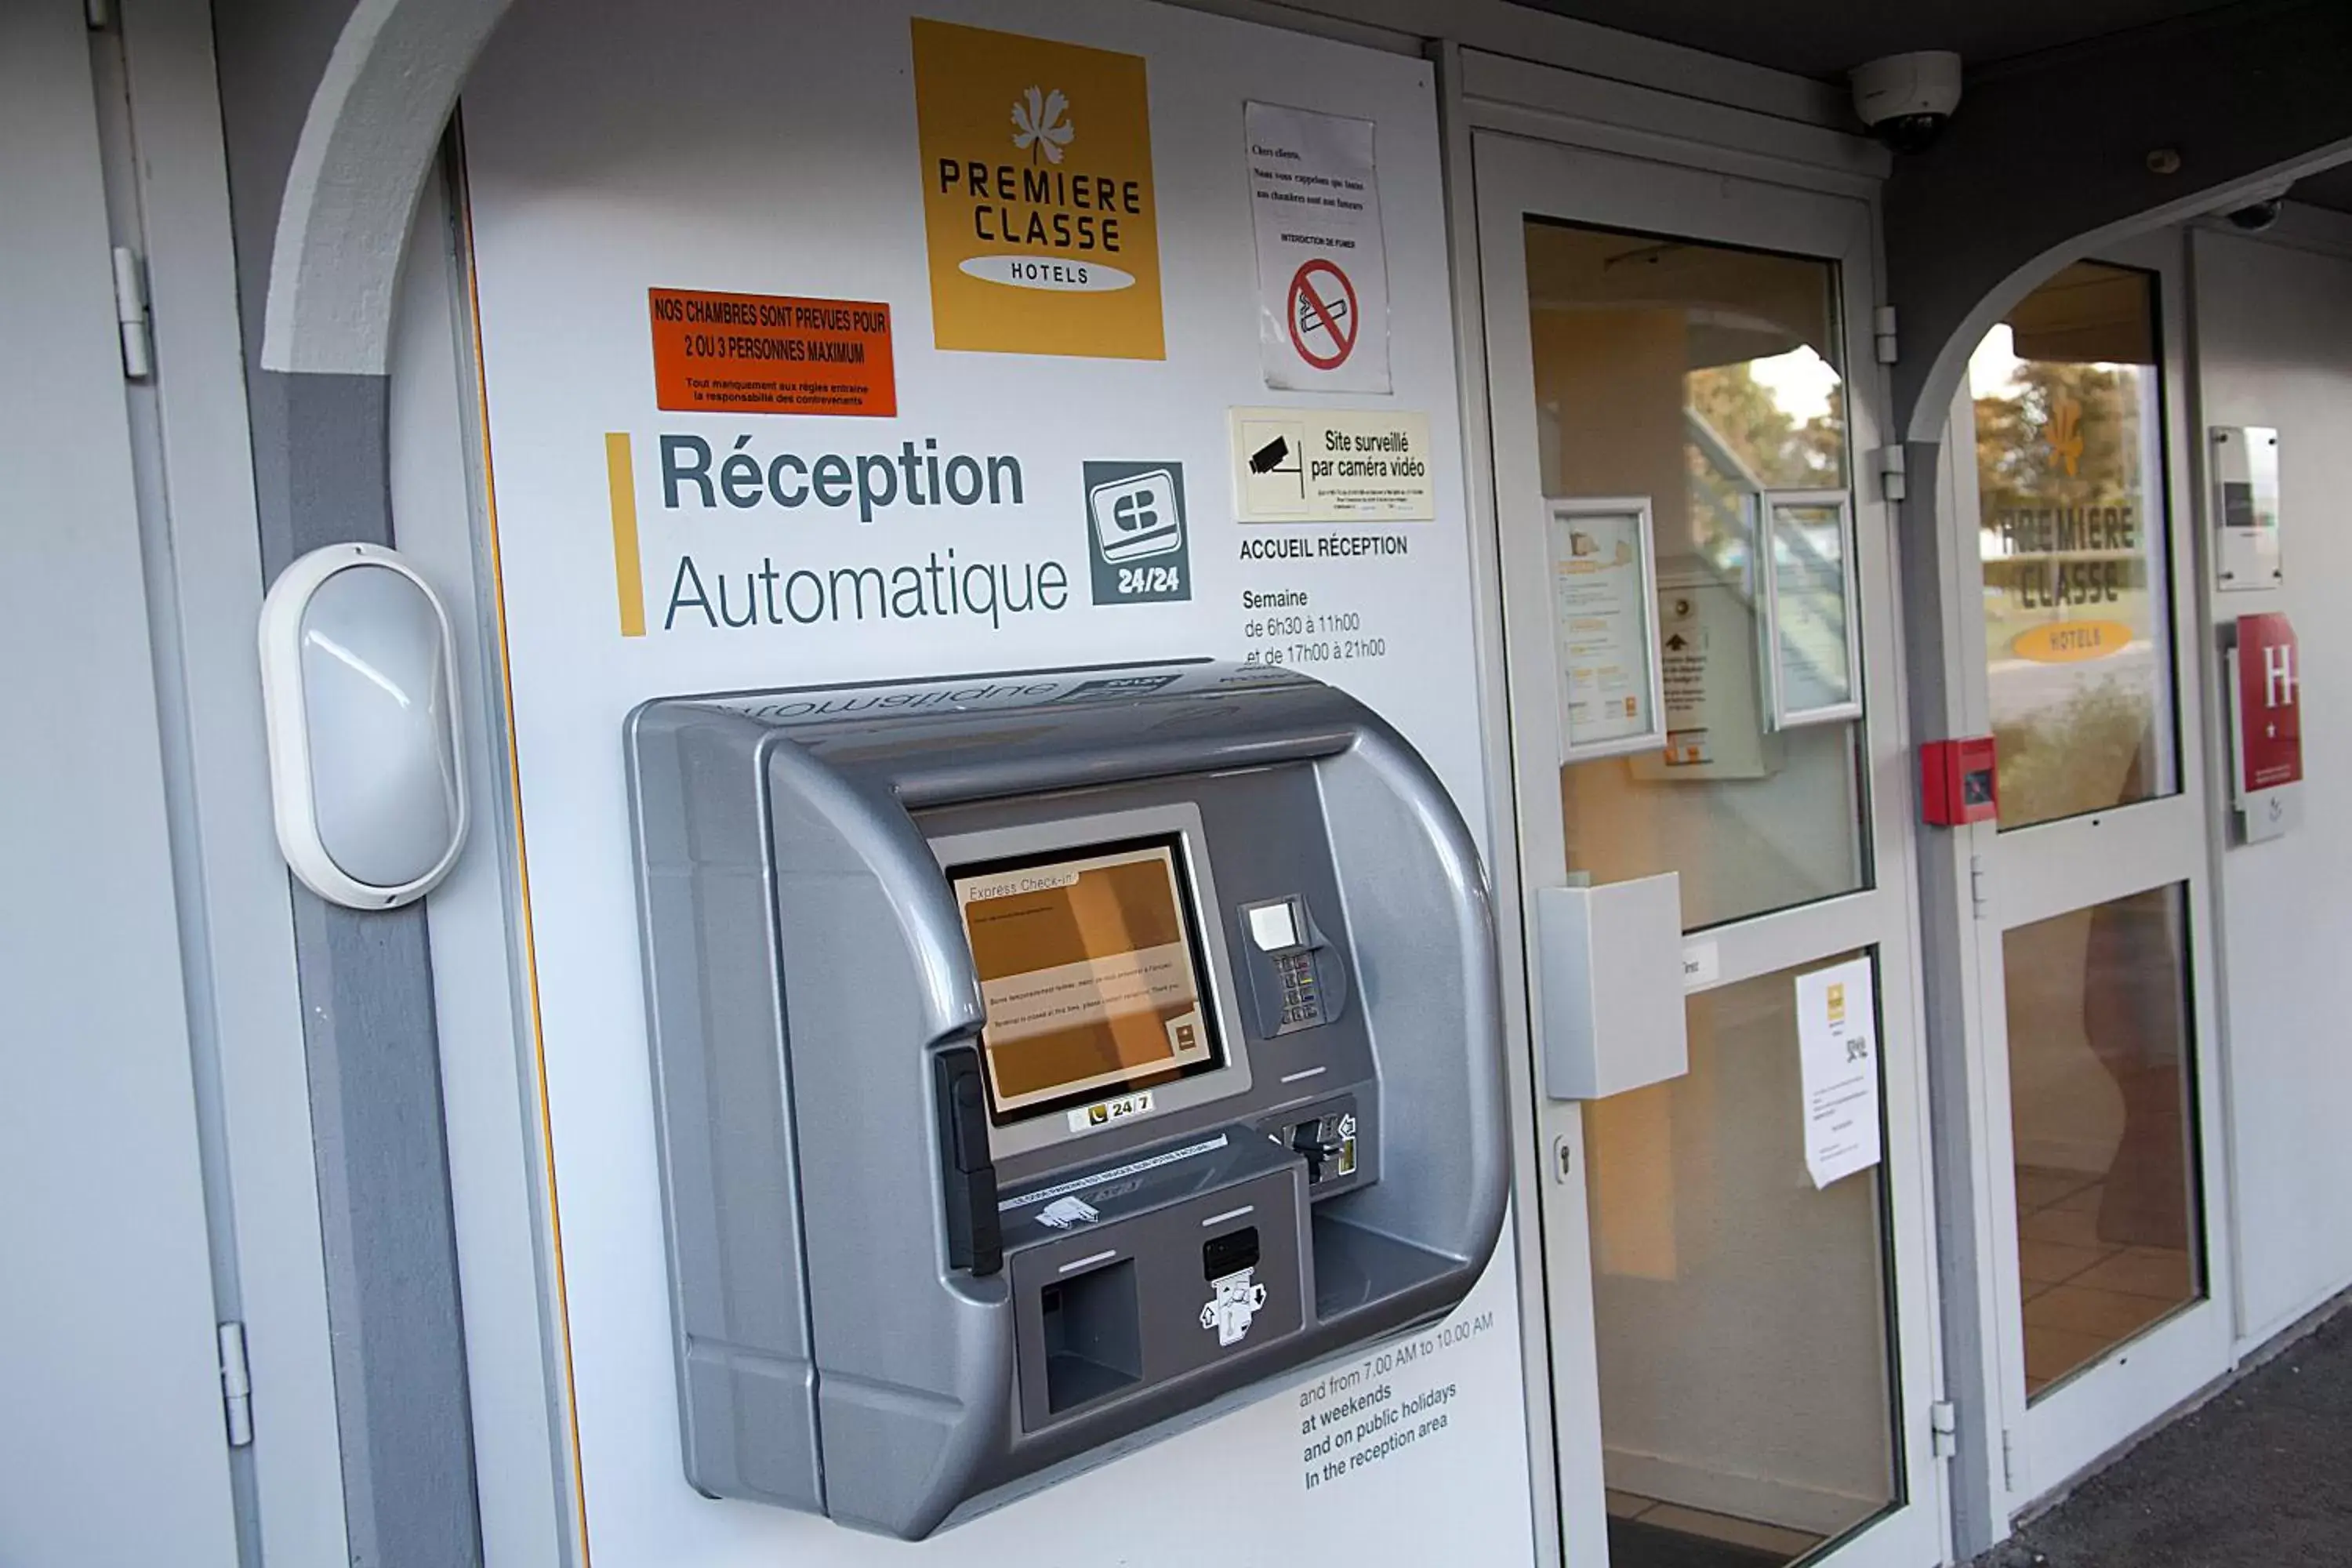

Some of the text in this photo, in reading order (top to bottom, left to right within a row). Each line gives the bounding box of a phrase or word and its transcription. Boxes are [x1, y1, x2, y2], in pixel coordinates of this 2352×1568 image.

[939, 158, 1140, 214] PREMIERE
[975, 205, 1120, 252] CLASSE
[1011, 263, 1088, 284] HOTELS
[655, 299, 887, 333] NOS CHAMBRES SONT PREVUES POUR
[684, 335, 865, 365] 2 OU 3 PERSONNES MAXIMUM
[686, 378, 709, 389] Tout
[1326, 430, 1409, 452] Site surveillé
[660, 434, 1022, 521] Réception
[1312, 457, 1425, 481] par caméra vidéo
[1240, 532, 1408, 561] ACCUEIL RÉCEPTION
[664, 547, 1068, 630] Automatique
[1118, 566, 1180, 594] 24/24
[2021, 561, 2118, 608] CLASSE
[1243, 589, 1308, 609] Semaine
[1245, 613, 1360, 637] de 6h30 à 11h00
[1265, 646, 1283, 665] de
[1287, 642, 1330, 662] 17h00
[1333, 642, 1342, 659] à
[1345, 638, 1385, 659] 21h00
[2263, 644, 2294, 708] H
[969, 873, 1073, 900] Express Check-in
[1300, 1312, 1494, 1408] and from 7.00 AM to 10.00 AM
[1302, 1384, 1392, 1435] at weekends
[1304, 1382, 1456, 1462] and on public holidays
[1305, 1414, 1448, 1490] In the reception area
